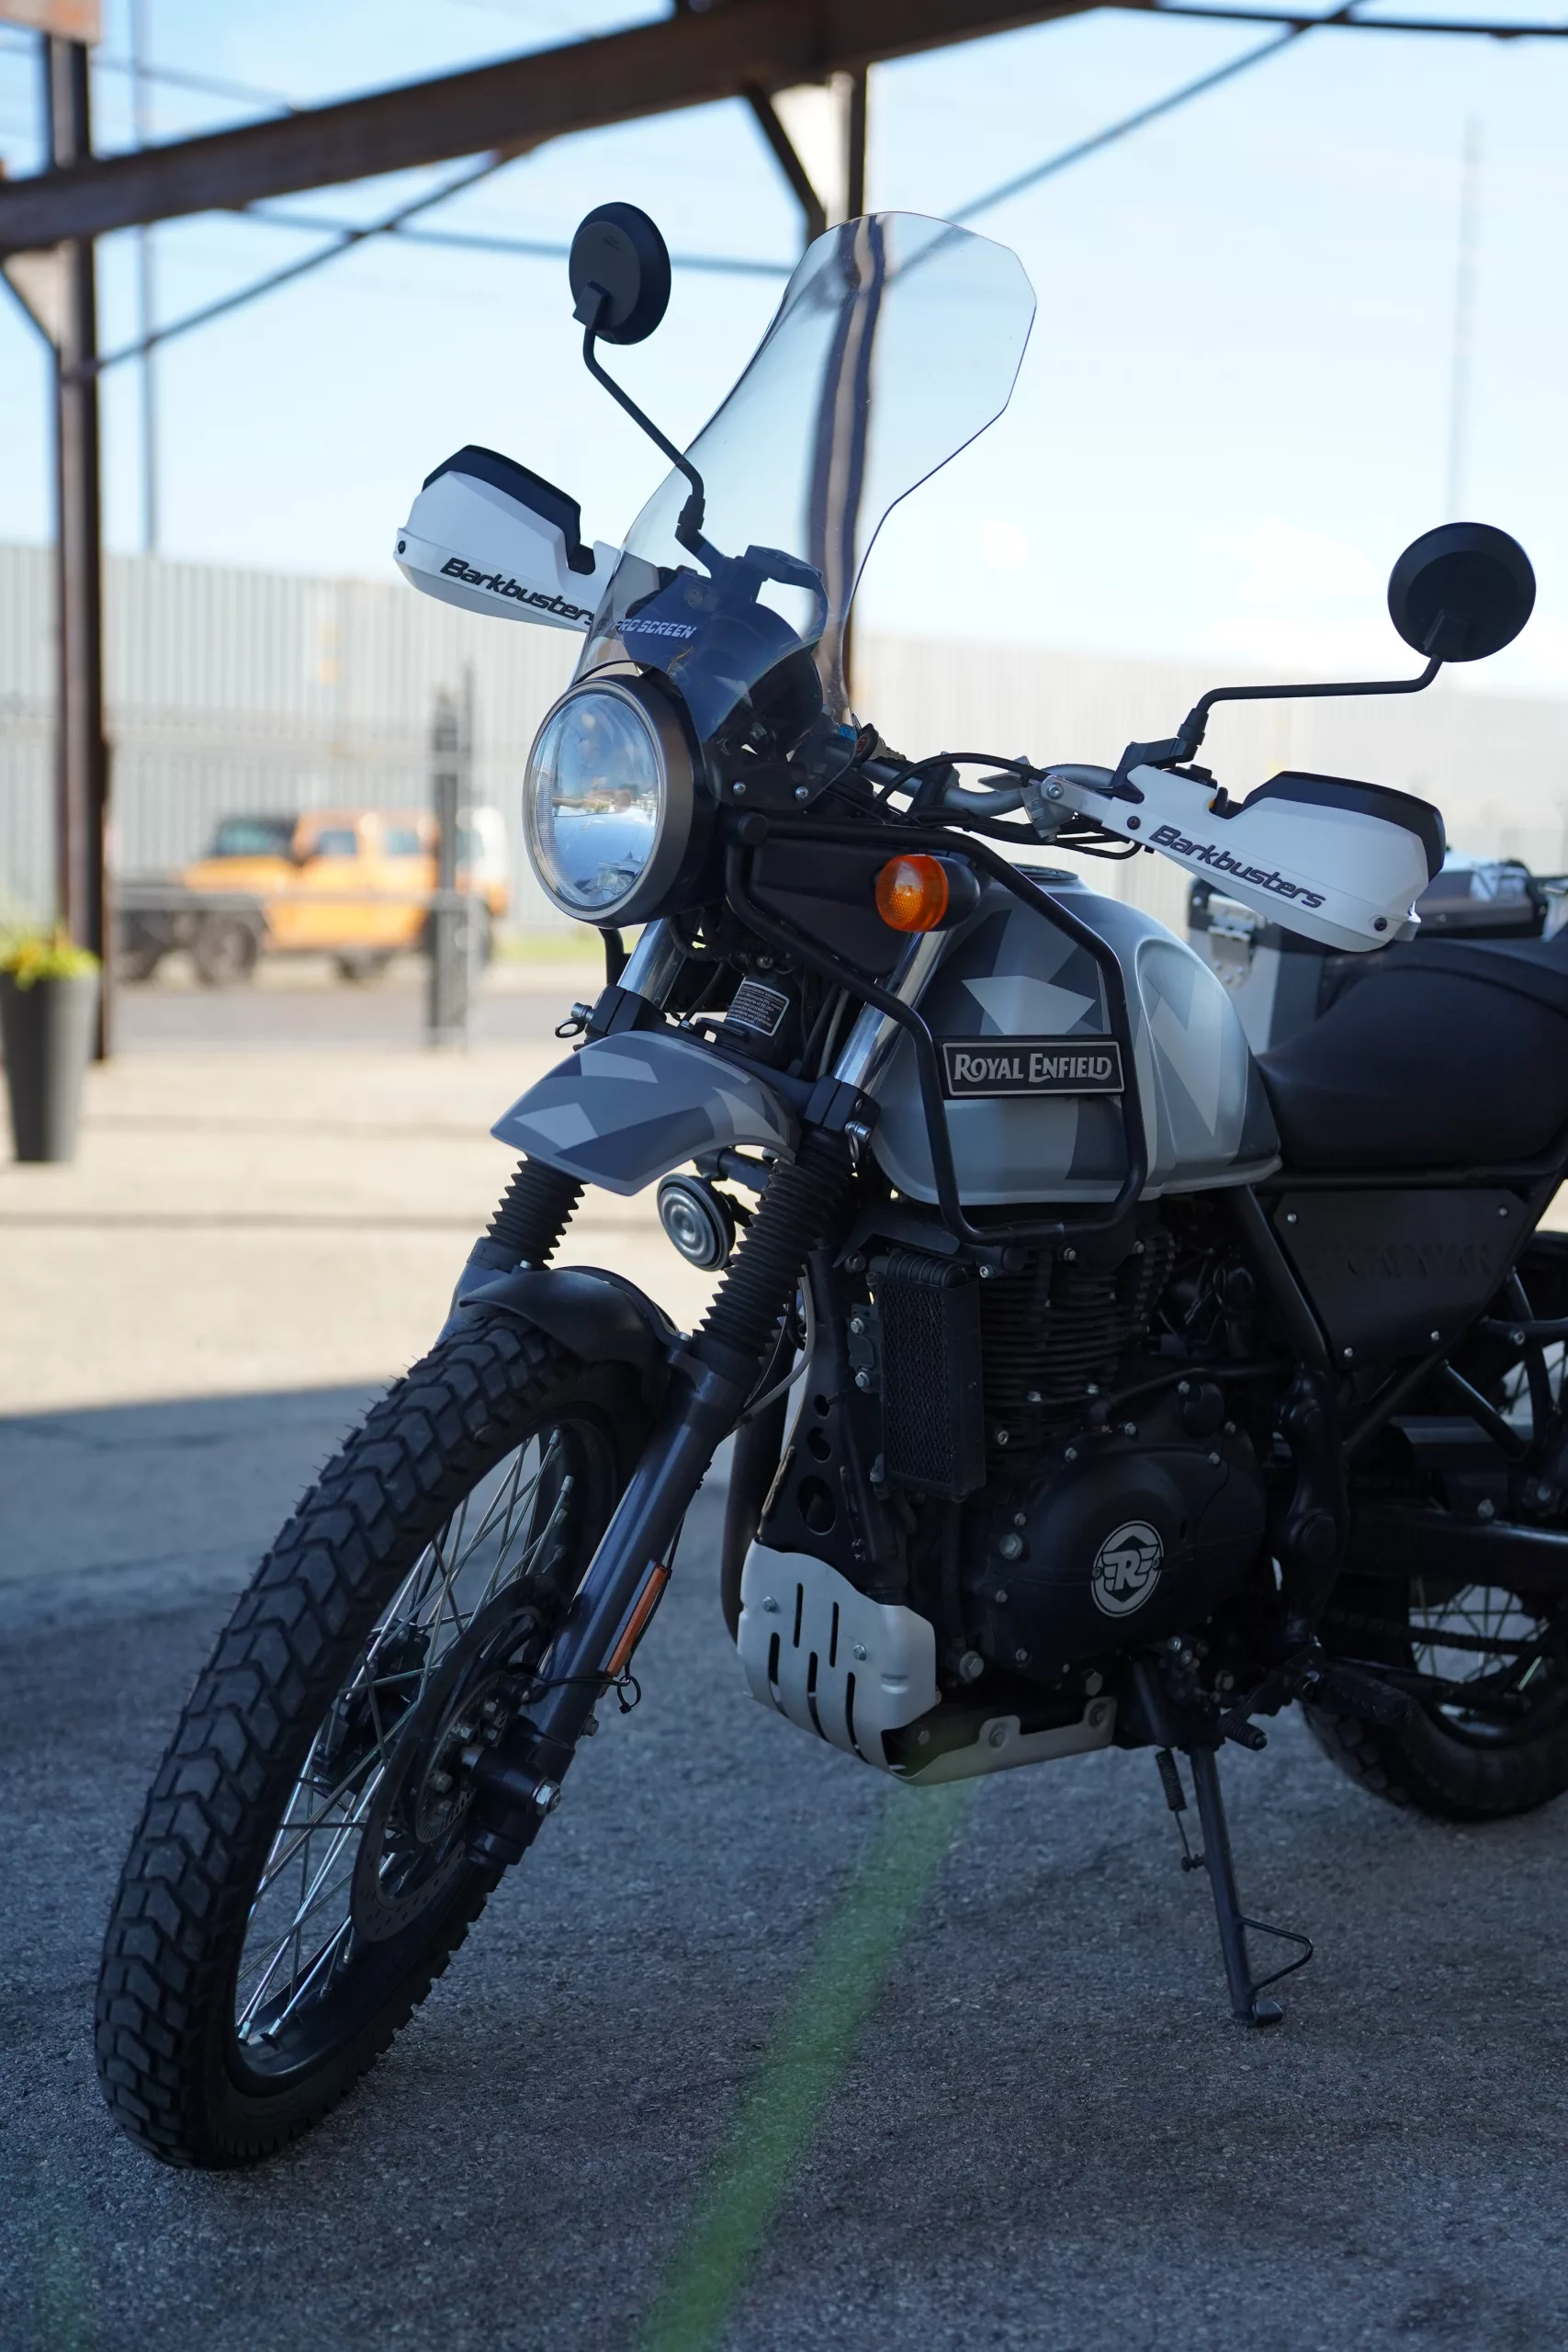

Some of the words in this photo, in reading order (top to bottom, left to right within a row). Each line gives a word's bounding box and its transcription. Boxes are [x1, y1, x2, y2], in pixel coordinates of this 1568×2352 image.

[637, 622, 697, 639] SCREEN
[1149, 824, 1326, 909] Barkbusters
[953, 1054, 1024, 1082] ROYAL
[1028, 1052, 1112, 1083] ENFIELD
